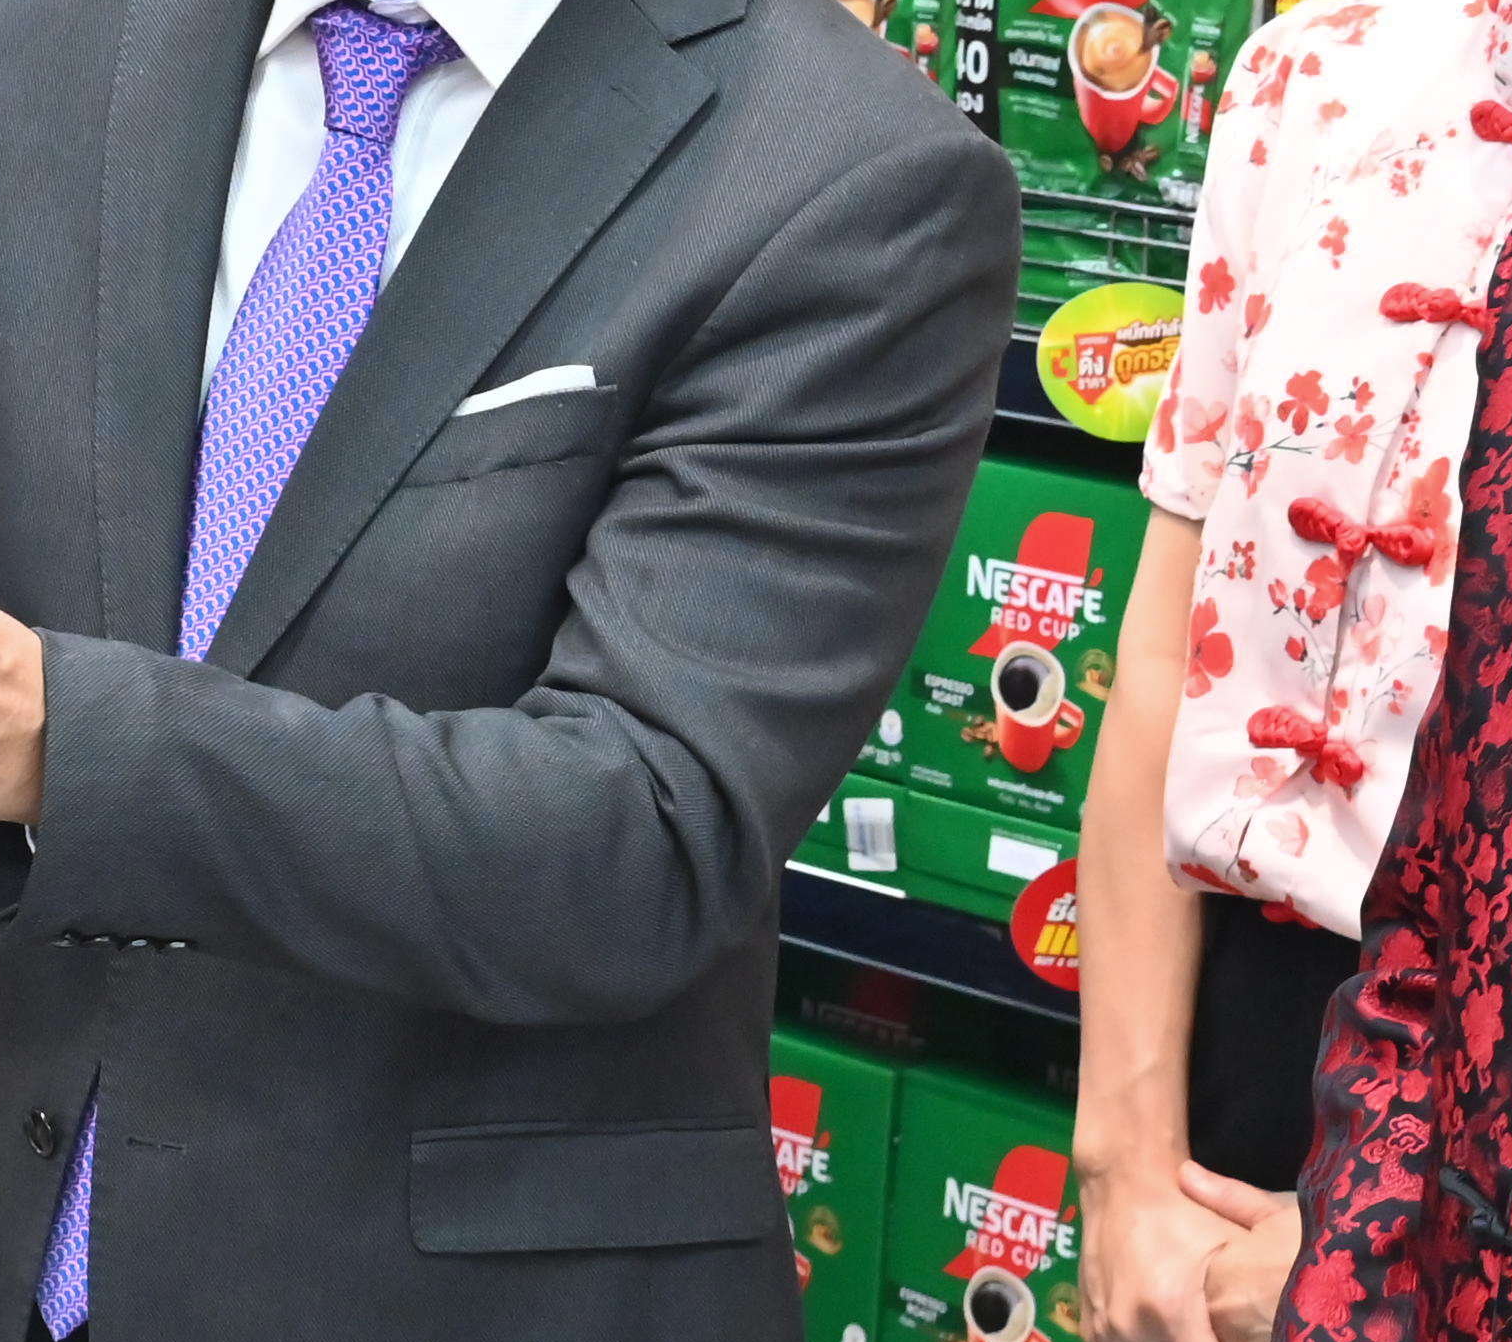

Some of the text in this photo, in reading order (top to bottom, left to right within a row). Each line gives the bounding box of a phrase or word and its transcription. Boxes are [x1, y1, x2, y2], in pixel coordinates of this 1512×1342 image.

[990, 606, 1082, 642] RED CUP
[965, 1229, 1054, 1272] RED CUP
